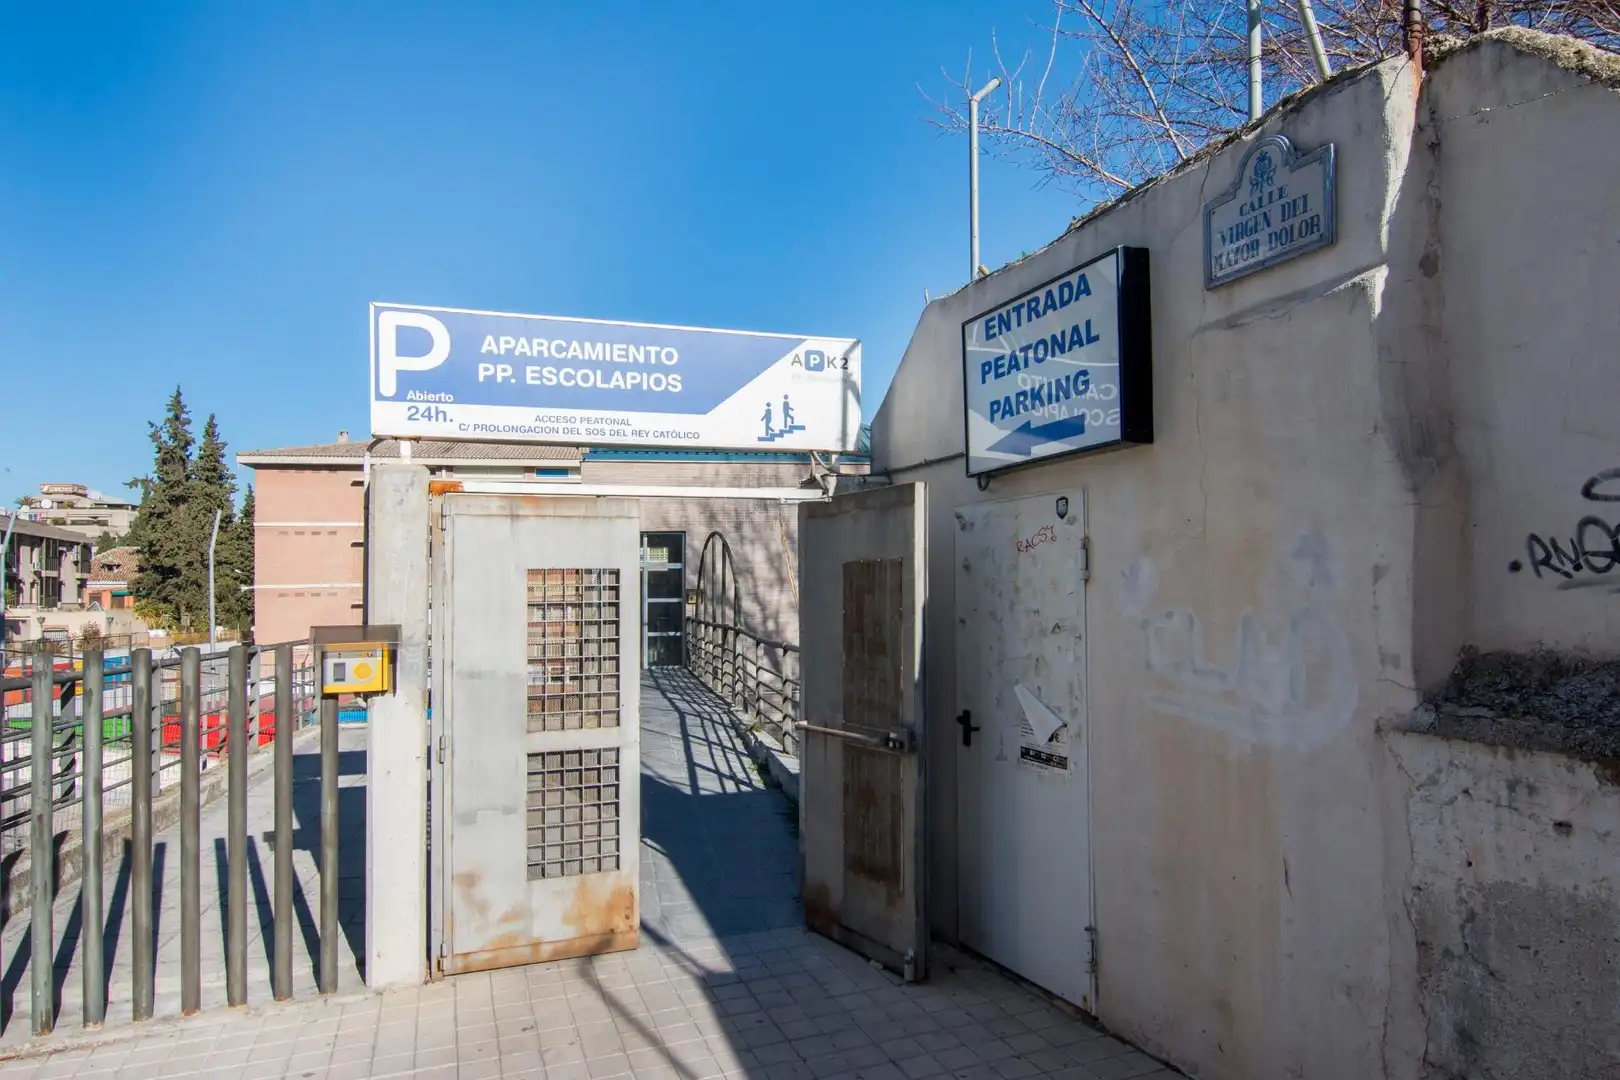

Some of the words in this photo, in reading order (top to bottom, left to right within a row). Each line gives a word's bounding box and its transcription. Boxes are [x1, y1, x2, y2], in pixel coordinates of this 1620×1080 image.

[1239, 184, 1289, 217] CALLE
[1219, 209, 1272, 247] VIRGEN
[1280, 193, 1313, 223] DEL
[1267, 213, 1321, 251] DOLOR
[984, 272, 1092, 341] ENTRADA
[378, 310, 451, 397] P
[480, 334, 678, 366] APARCAMIENTO
[980, 318, 1100, 385] PEATONAL
[478, 362, 516, 384] PP.
[526, 365, 682, 393] ESCOLAPIOS
[406, 389, 454, 402] Abierto
[988, 368, 1091, 424] PARKING
[406, 405, 454, 423] 24h.
[534, 414, 577, 424] ACCESO
[580, 416, 632, 427] PEATONAL
[473, 423, 559, 435] PROLONGACION
[562, 427, 582, 436] DEL
[585, 428, 606, 436] SOS
[609, 428, 628, 437] DEL
[631, 429, 650, 438] REY
[652, 429, 700, 440] CATÓLICO
